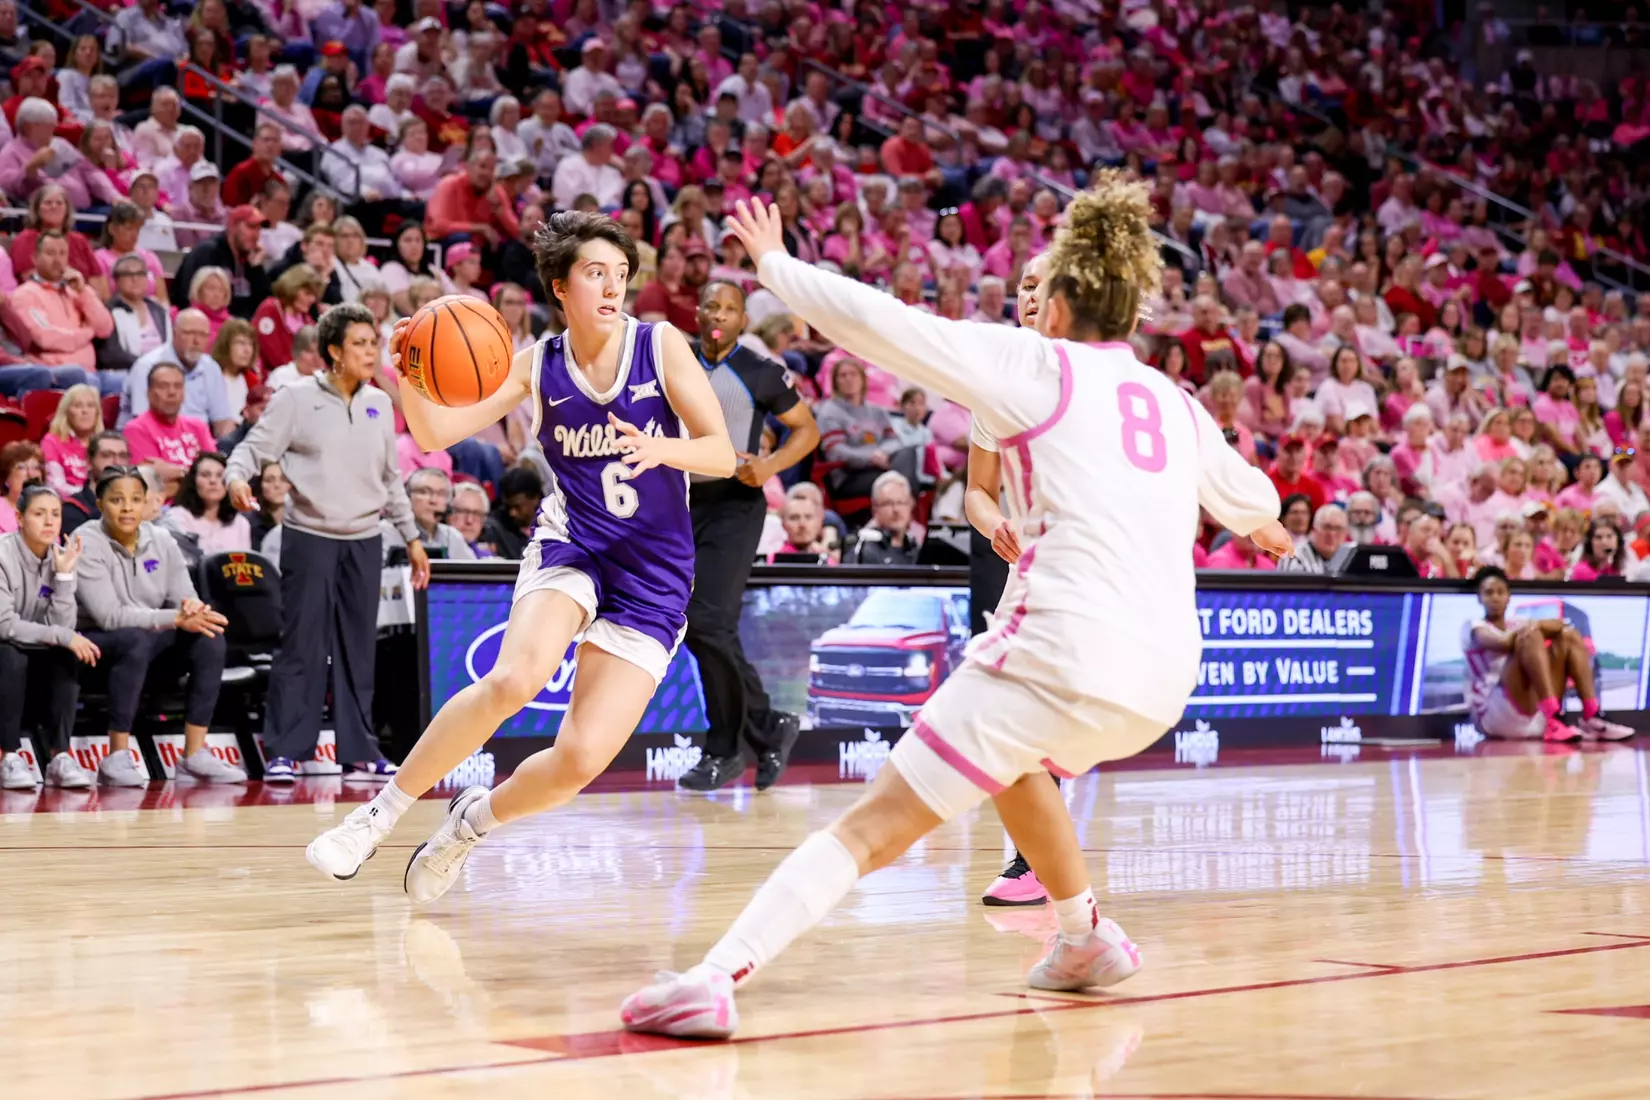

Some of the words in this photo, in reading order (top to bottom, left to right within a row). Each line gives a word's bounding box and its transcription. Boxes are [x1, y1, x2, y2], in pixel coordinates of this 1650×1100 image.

[1117, 382, 1167, 473] 8
[601, 461, 640, 519] 6
[221, 562, 264, 578] STATE
[1218, 608, 1277, 635] FORD
[1283, 608, 1373, 636] DEALERS
[1242, 661, 1269, 685] BY
[1275, 657, 1339, 684] VALUE
